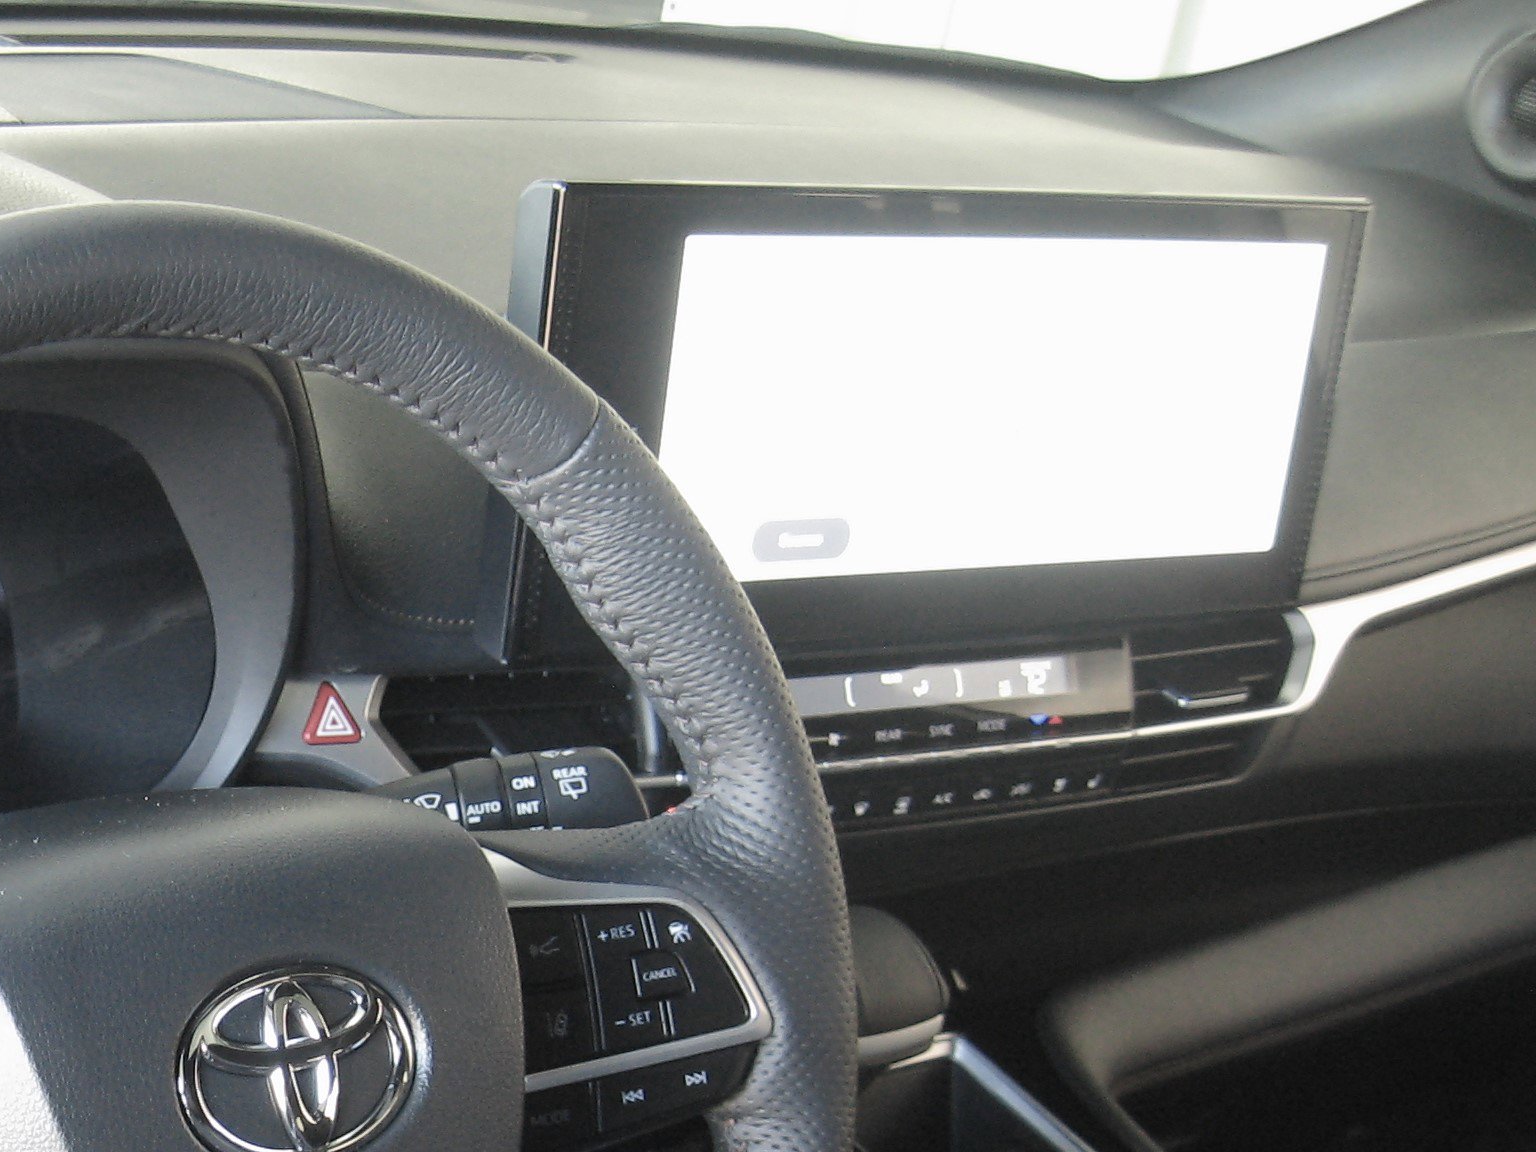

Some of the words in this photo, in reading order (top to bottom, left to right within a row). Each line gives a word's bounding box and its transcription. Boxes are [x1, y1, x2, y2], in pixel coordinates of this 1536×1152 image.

[552, 765, 588, 780] REAR
[511, 775, 535, 790] ON
[466, 801, 502, 817] AUTO
[516, 800, 541, 815] INT
[642, 967, 678, 982] CANCEL
